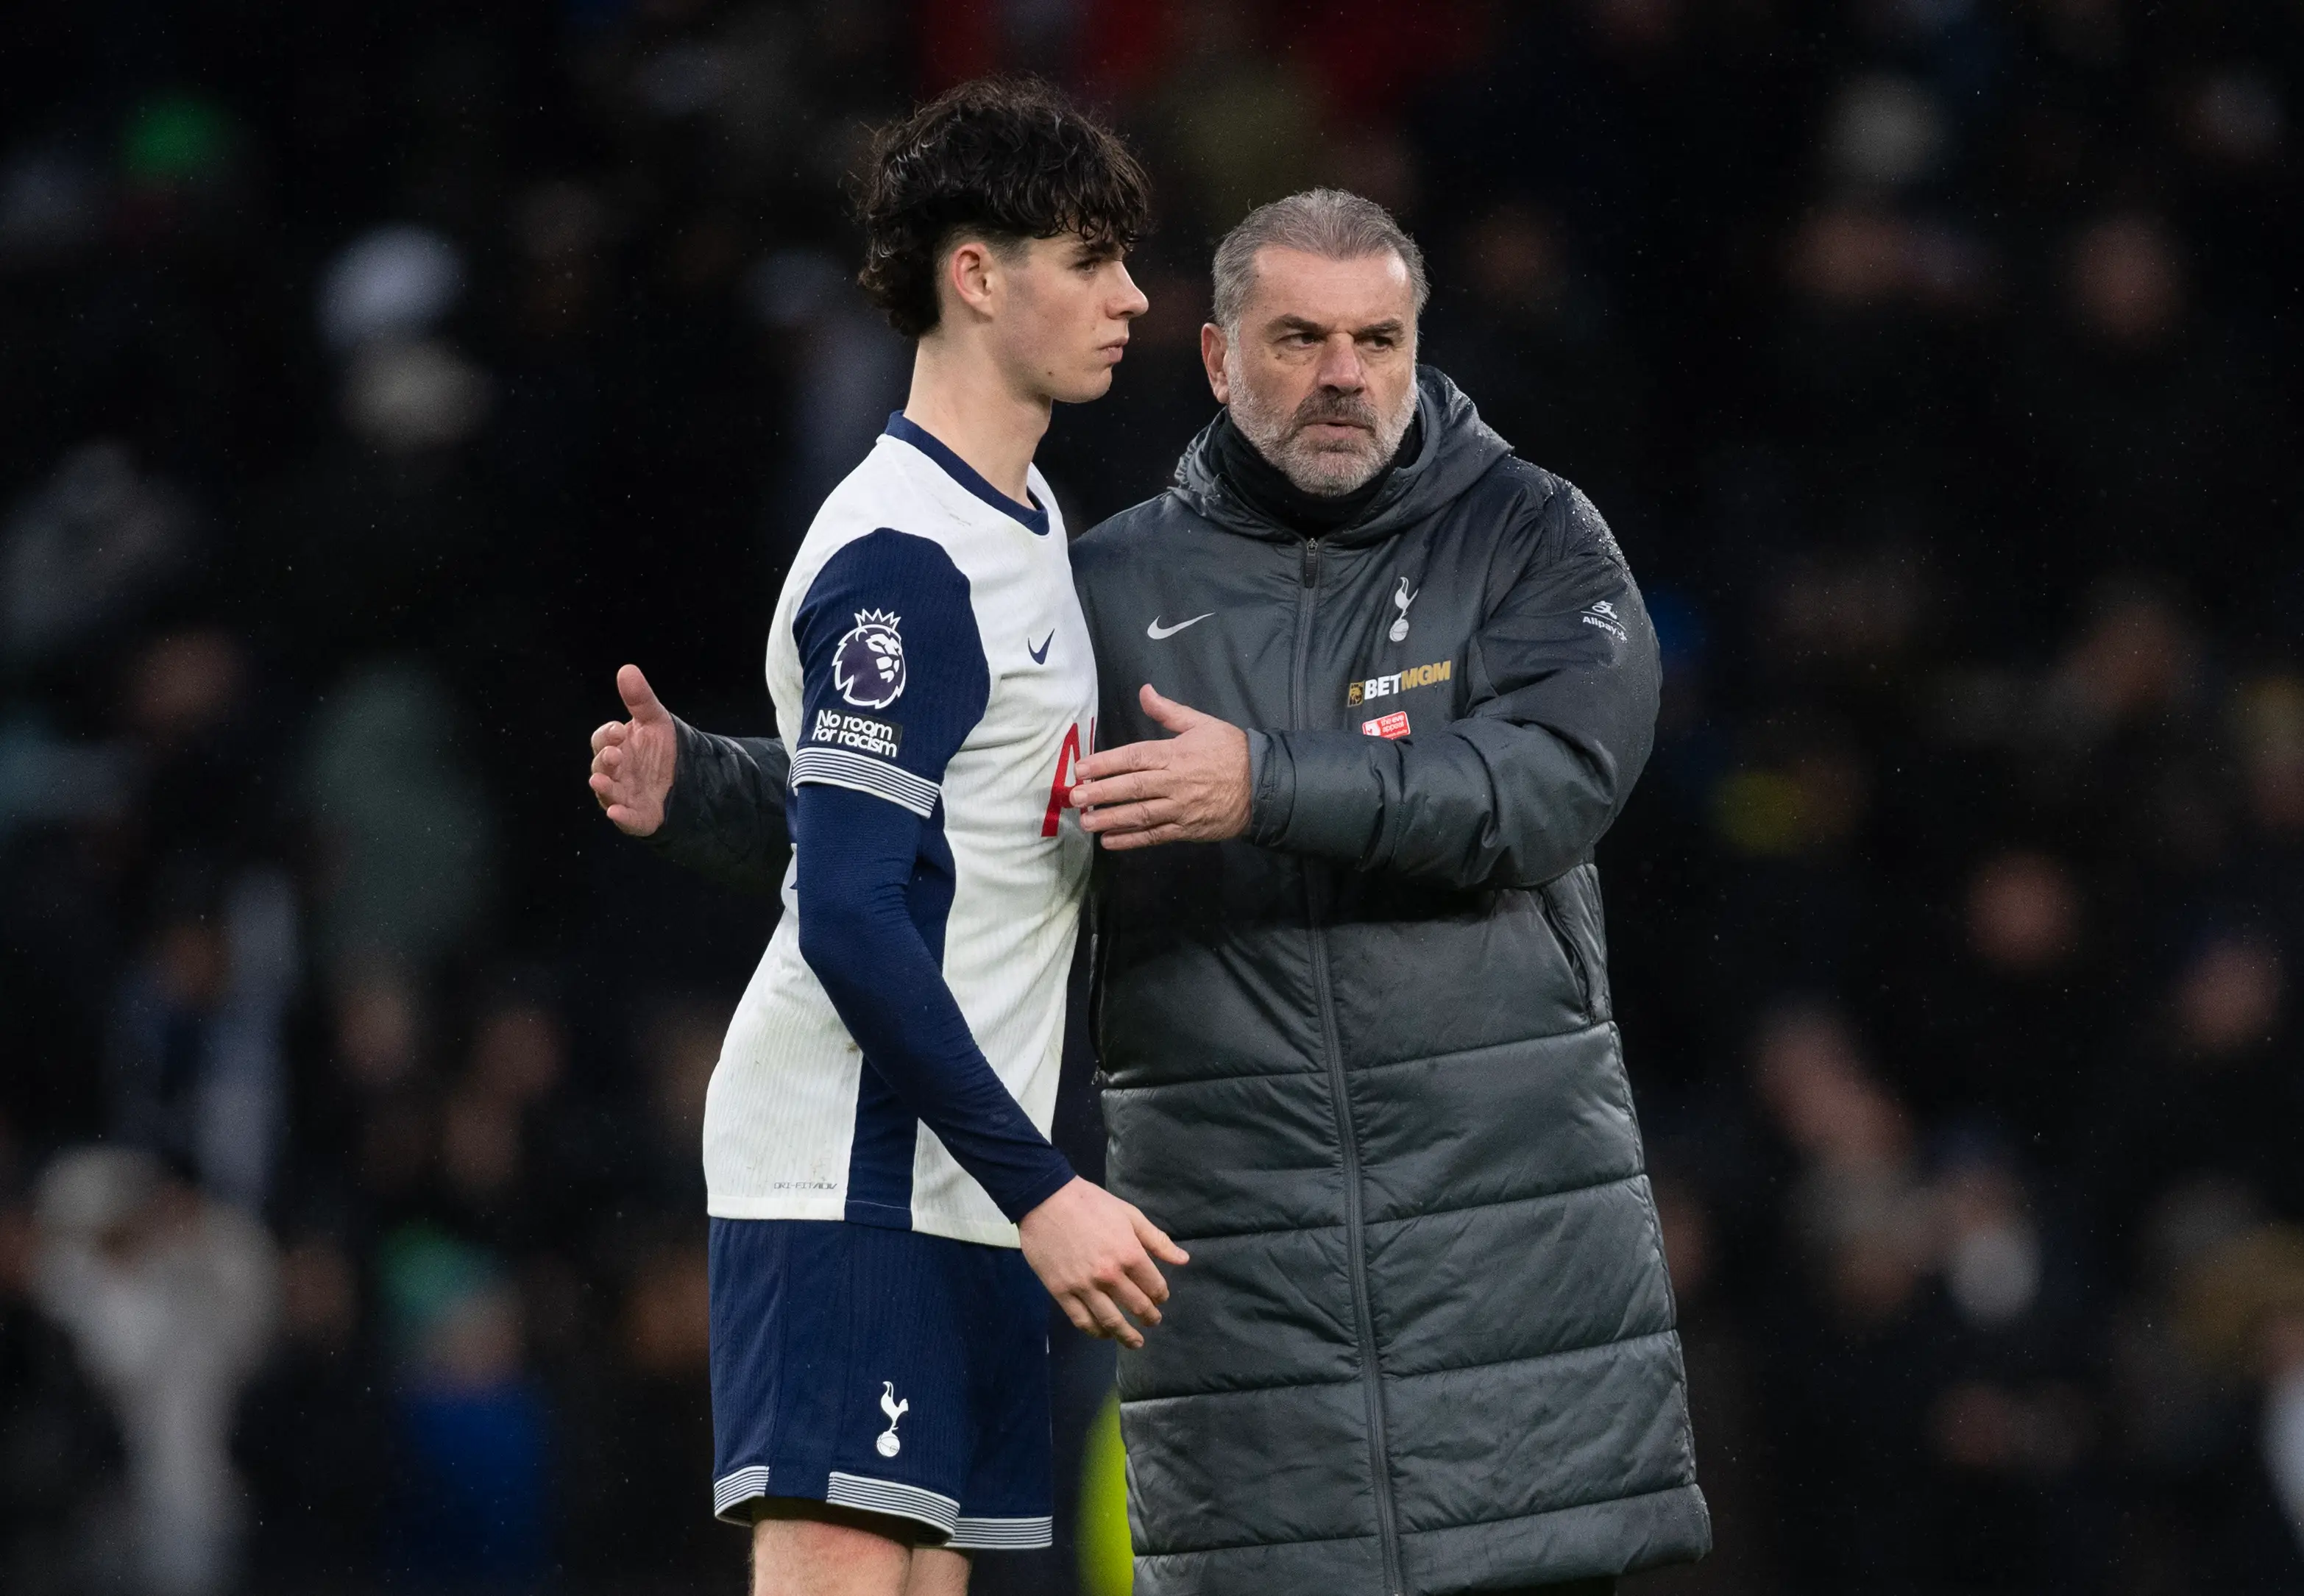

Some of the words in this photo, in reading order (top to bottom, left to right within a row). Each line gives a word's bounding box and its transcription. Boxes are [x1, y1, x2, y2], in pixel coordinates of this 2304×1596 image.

[812, 724, 838, 742] for
[838, 730, 897, 758] racism
[817, 709, 841, 728] No
[843, 715, 893, 741] room
